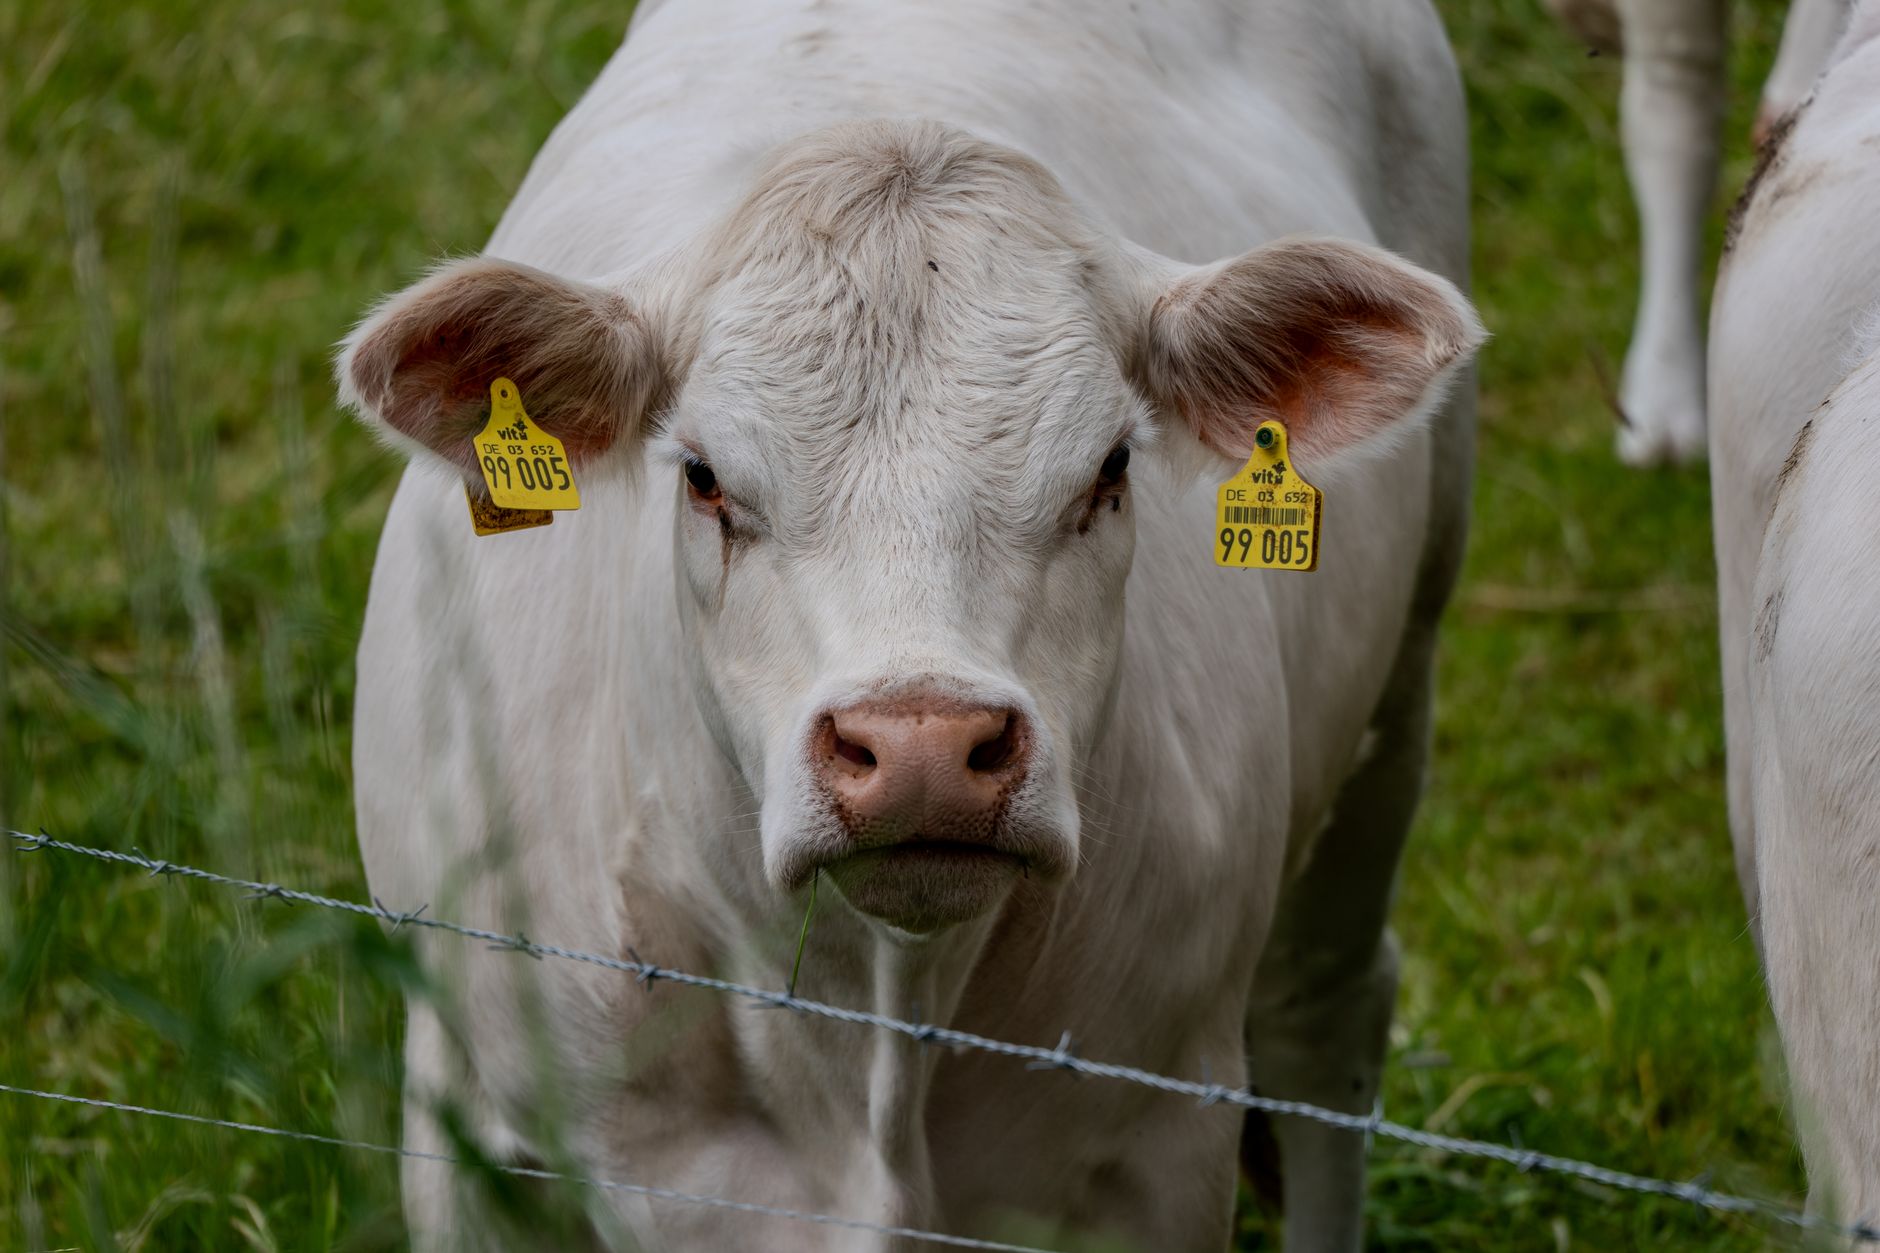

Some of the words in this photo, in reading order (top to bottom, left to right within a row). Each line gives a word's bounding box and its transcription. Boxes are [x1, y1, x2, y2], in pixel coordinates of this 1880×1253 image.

[483, 443, 501, 455] DE
[507, 445, 524, 455] 03
[531, 445, 556, 455] 652
[483, 455, 511, 490] 99
[516, 457, 570, 491] 005
[1226, 489, 1247, 502] DE
[1257, 491, 1274, 502] 03
[1284, 492, 1308, 503] 652
[1220, 527, 1253, 563] 99
[1262, 529, 1309, 565] 005
